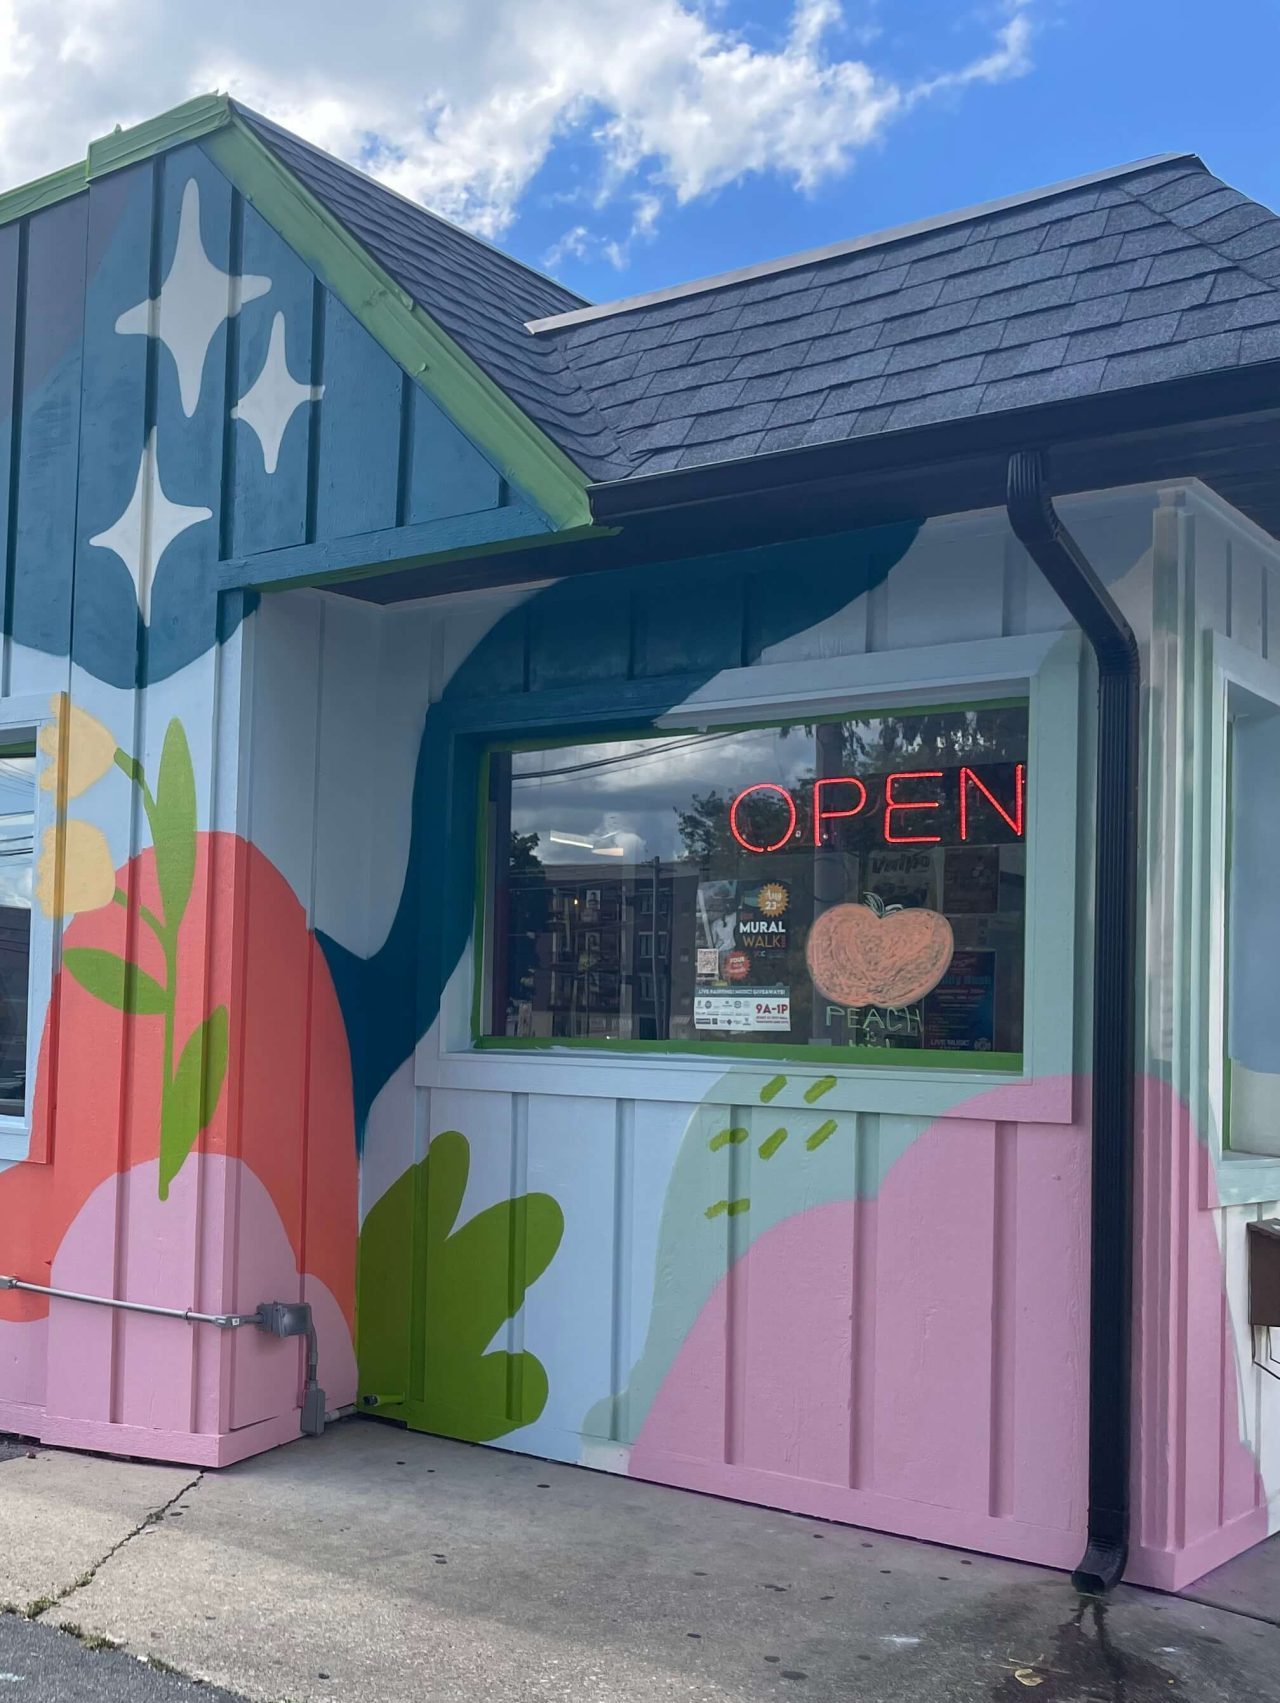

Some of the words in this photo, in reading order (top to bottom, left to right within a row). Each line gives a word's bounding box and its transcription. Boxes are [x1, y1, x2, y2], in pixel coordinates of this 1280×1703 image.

[730, 764, 1024, 853] OPEN
[739, 921, 786, 933] MURAL
[742, 935, 781, 948] WALK
[755, 1003, 788, 1014] 9A-1P
[826, 1005, 924, 1033] PEACH
